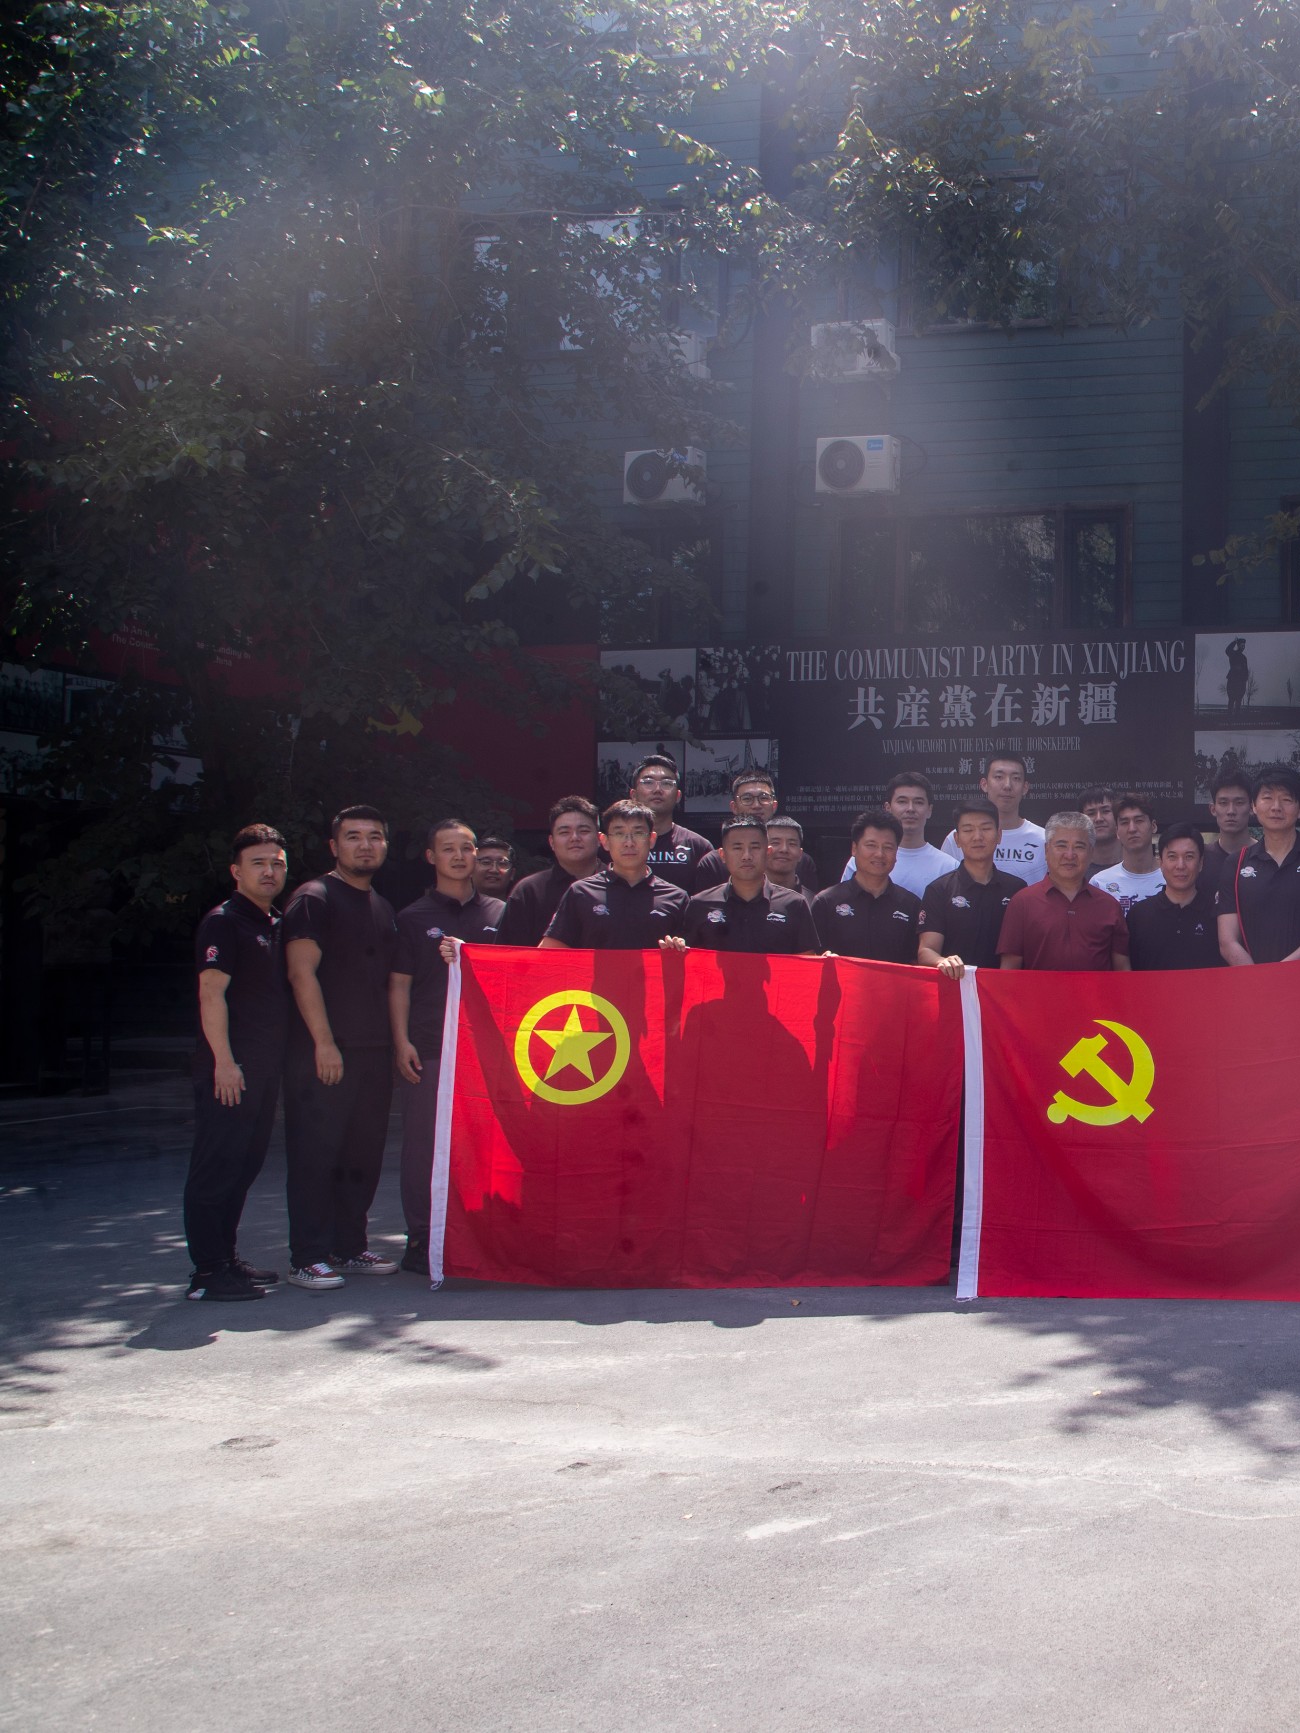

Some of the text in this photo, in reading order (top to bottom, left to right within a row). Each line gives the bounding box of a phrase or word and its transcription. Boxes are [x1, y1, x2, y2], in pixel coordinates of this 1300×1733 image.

[786, 640, 1186, 682] THE COMMUNIST PARTY IN XINJIANG
[881, 736, 1081, 755] XINJIANG MEMORY IN THE EYES OF THE HORSEKEEPER
